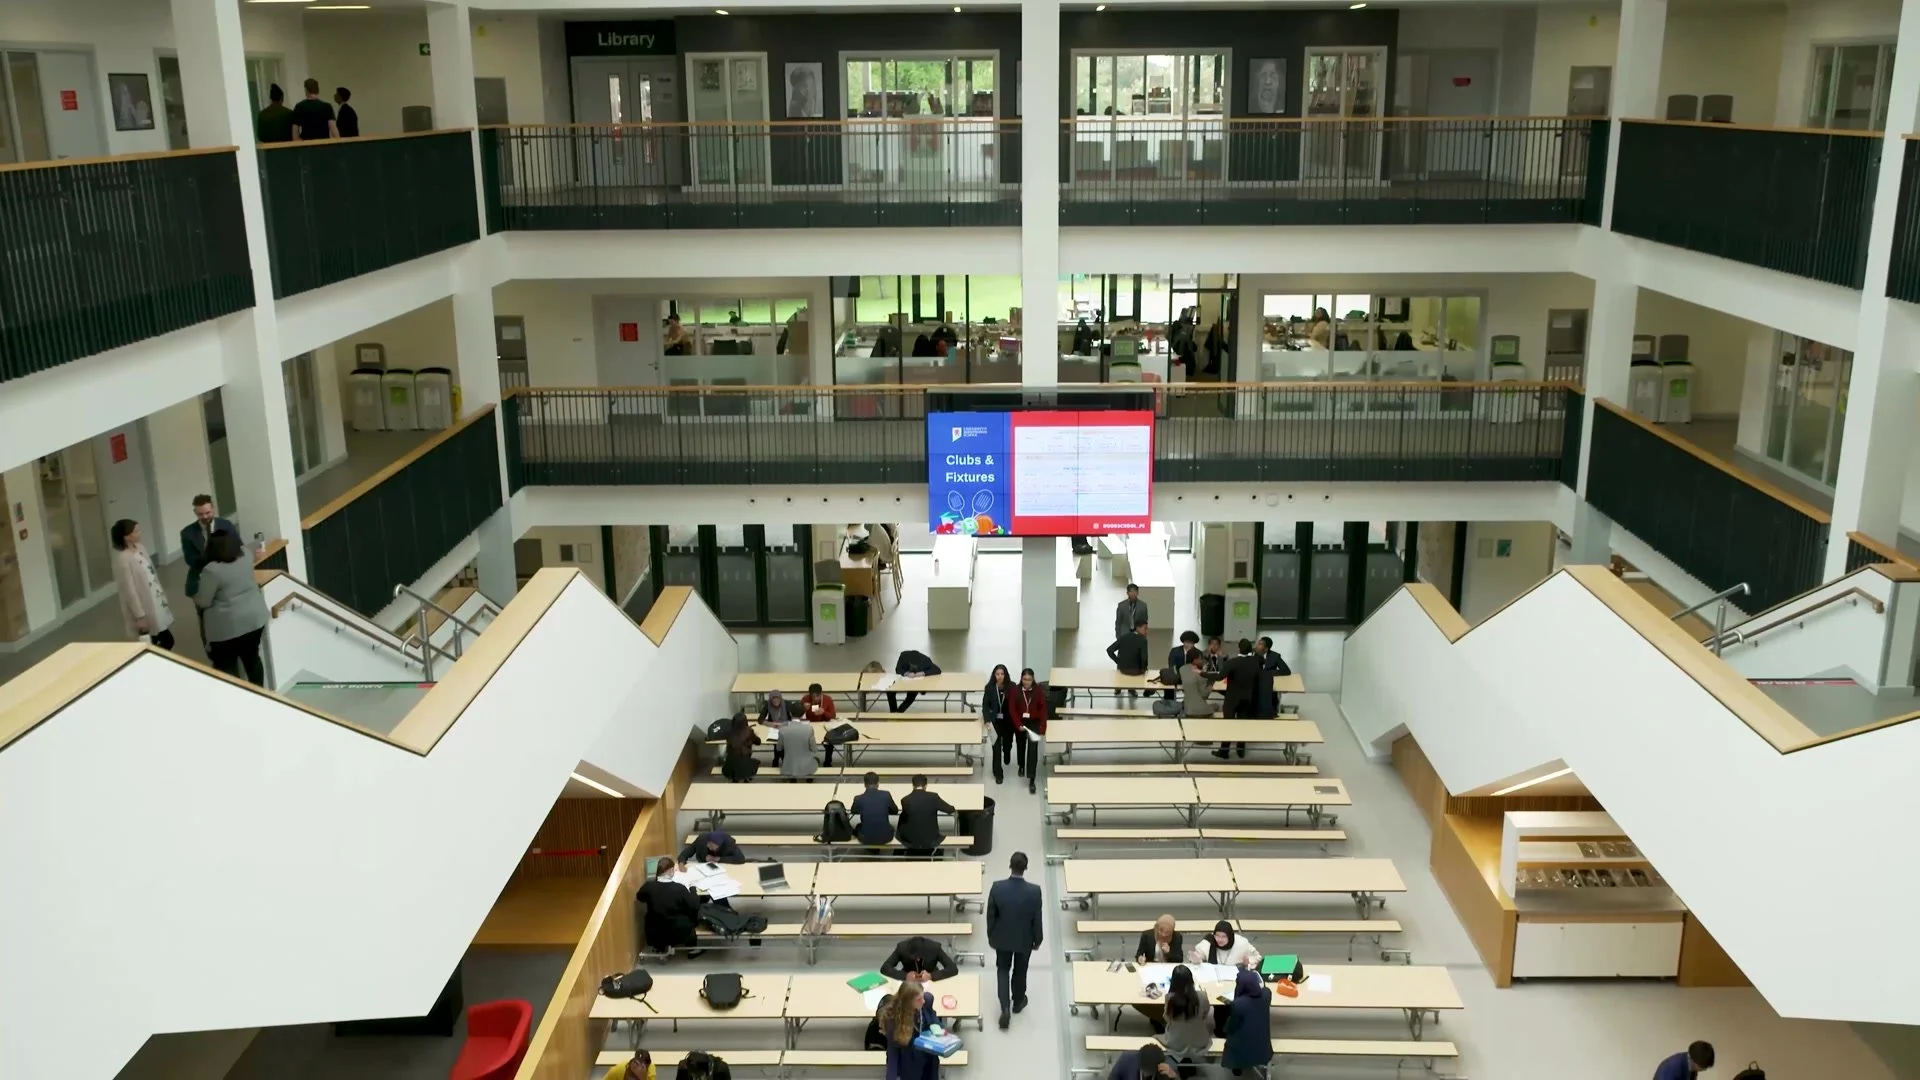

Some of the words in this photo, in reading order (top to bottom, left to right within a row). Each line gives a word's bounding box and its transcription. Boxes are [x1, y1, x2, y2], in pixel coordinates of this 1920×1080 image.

[598, 32, 655, 48] Library
[946, 454, 981, 465] Clubs
[985, 454, 994, 465] &
[945, 471, 995, 483] Fixtures
